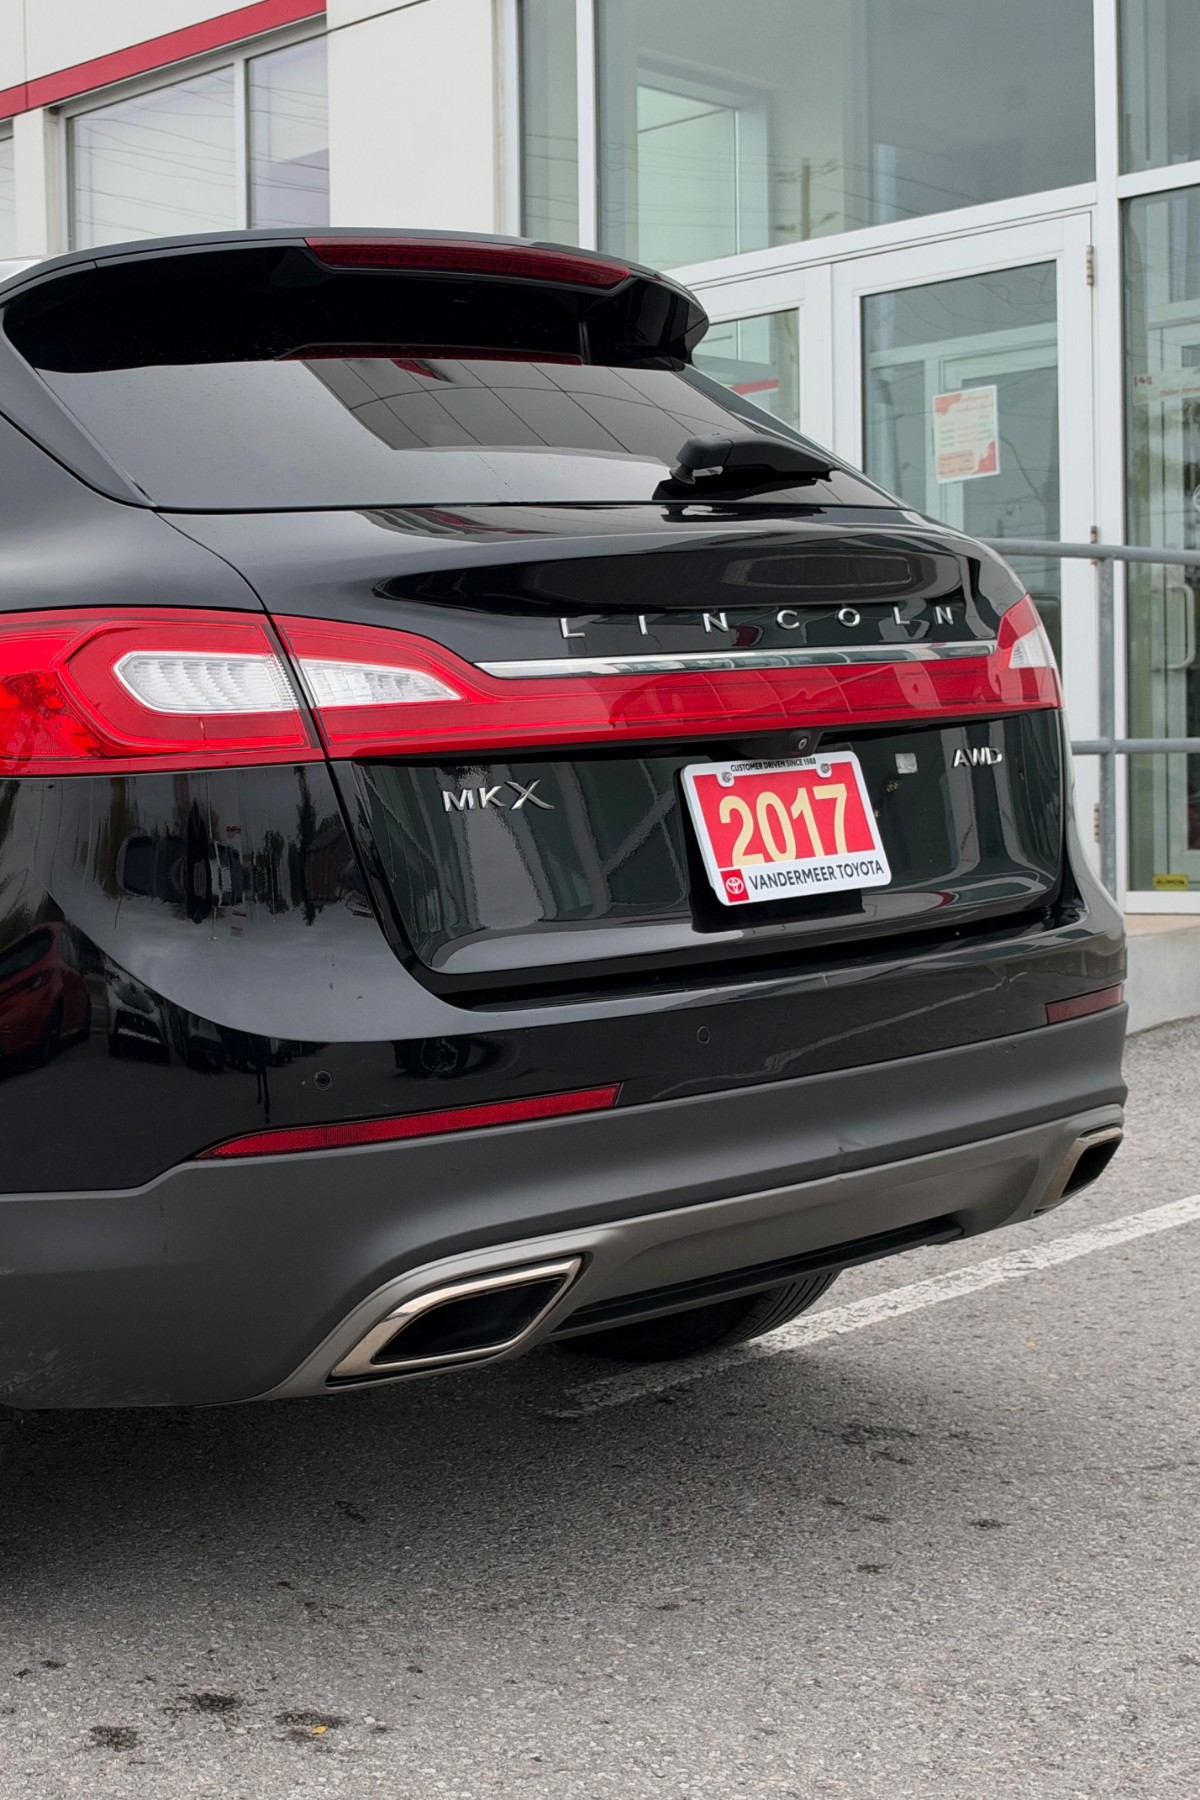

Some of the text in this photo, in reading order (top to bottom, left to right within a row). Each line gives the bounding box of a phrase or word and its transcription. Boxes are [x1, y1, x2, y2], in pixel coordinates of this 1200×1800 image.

[560, 605, 953, 639] LINCOLN
[730, 761, 763, 772] CUSTOMER
[763, 759, 786, 769] DRIVEN
[786, 758, 803, 767] SINCE
[952, 746, 1003, 768] AWD
[442, 779, 556, 811] MKX
[718, 783, 848, 867] 2017
[748, 859, 885, 891] VANDERMEER TOYOTA
